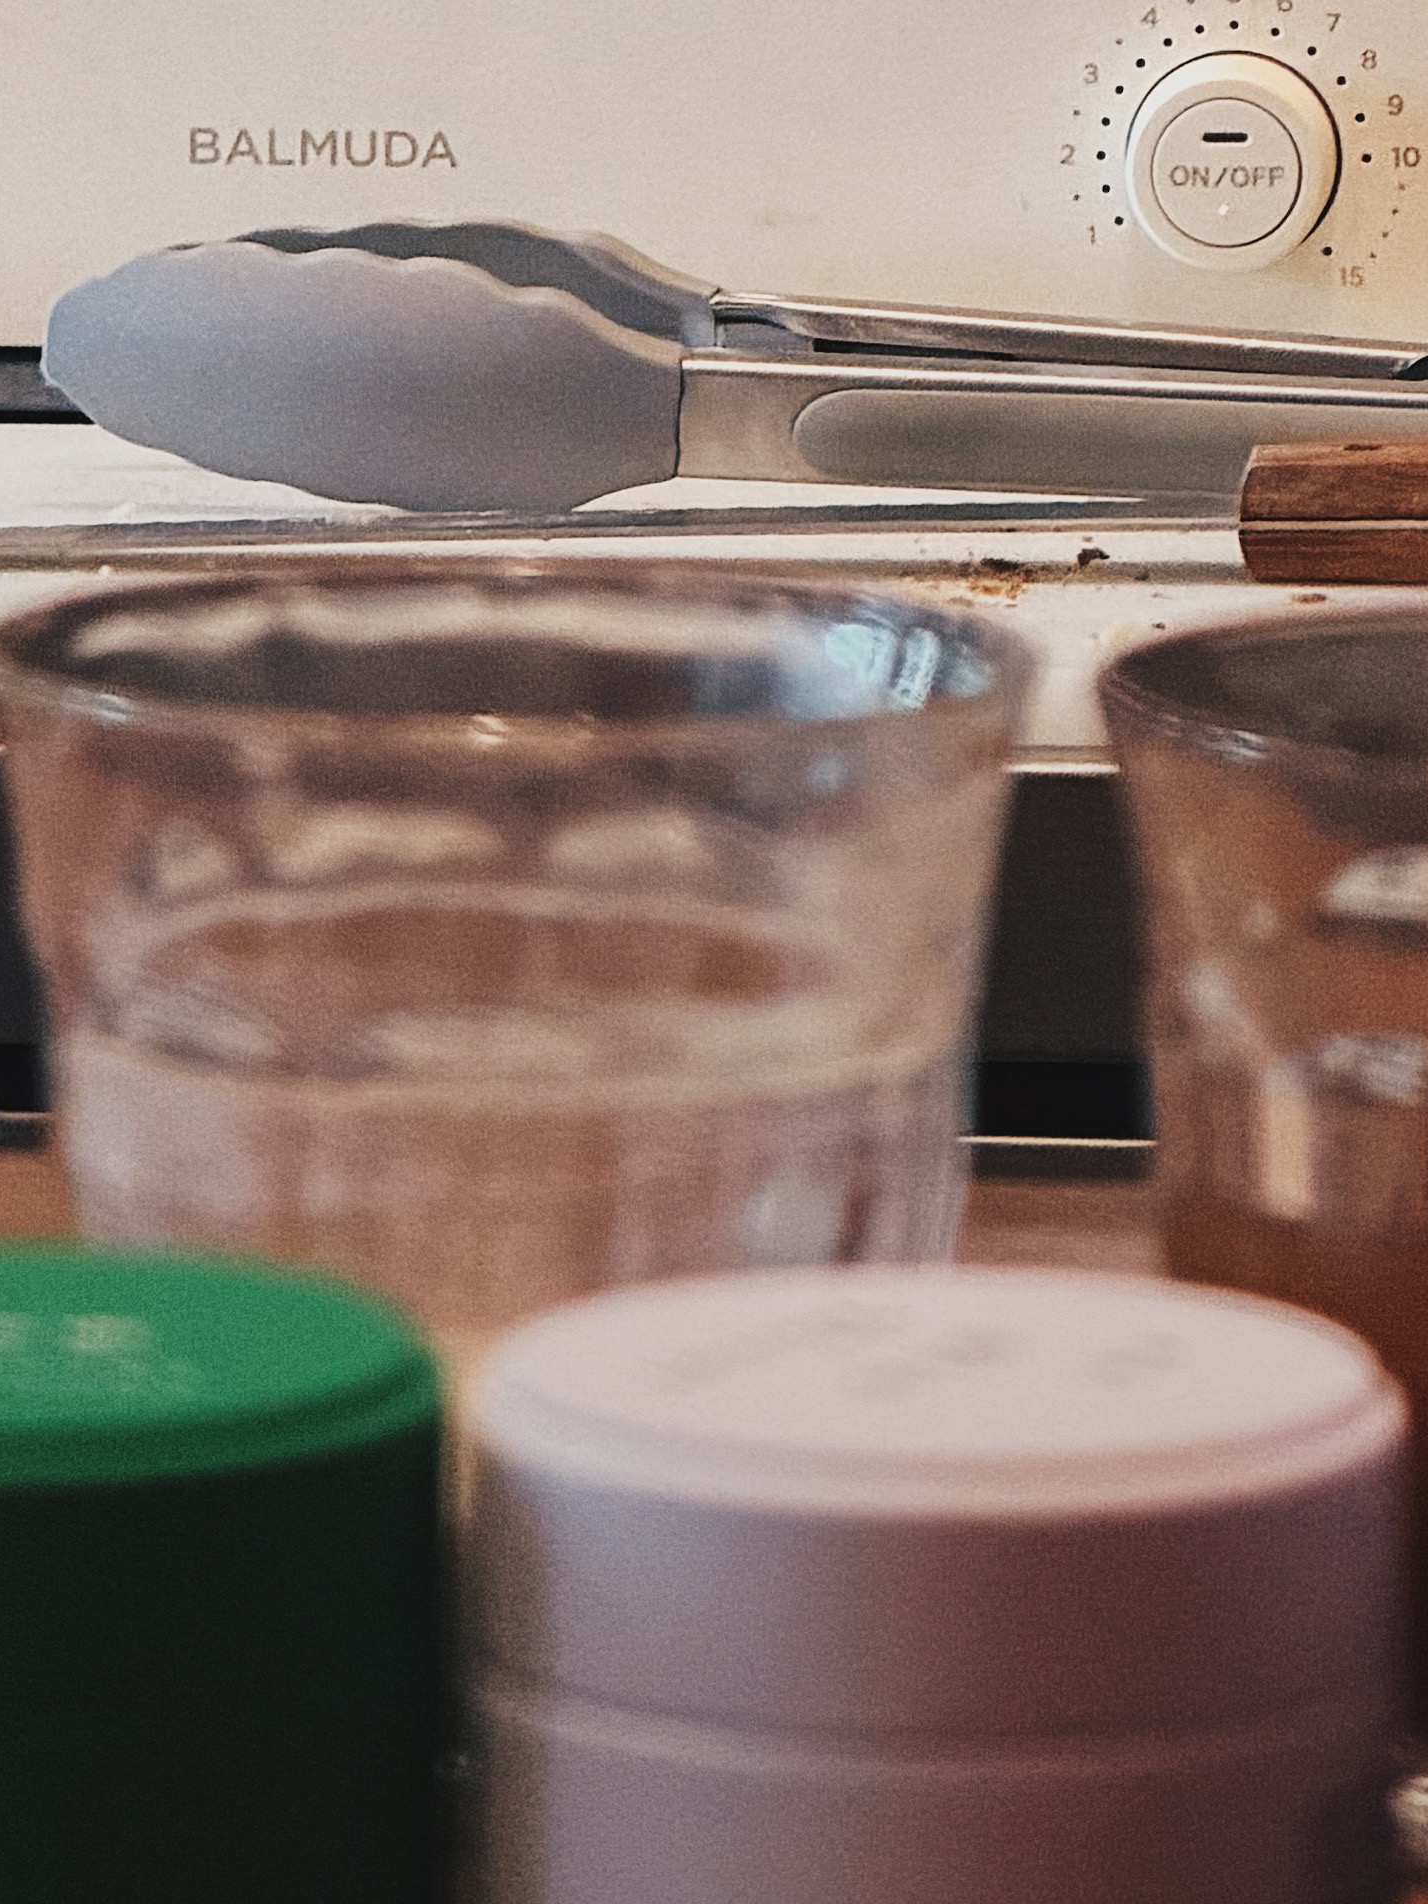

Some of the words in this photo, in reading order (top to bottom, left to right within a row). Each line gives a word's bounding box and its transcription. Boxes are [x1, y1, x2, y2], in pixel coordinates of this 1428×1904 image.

[1141, 7, 1159, 28] 4
[1326, 13, 1342, 33] 7
[1361, 49, 1378, 70] 8
[1083, 63, 1099, 84] 3
[1387, 94, 1404, 116] 9
[188, 127, 458, 168] BALMUDA
[1059, 145, 1075, 166] 2
[1391, 146, 1420, 168] 10
[1169, 164, 1285, 188] ON/OFF
[1088, 225, 1097, 245] 1
[1338, 266, 1366, 288] 15
